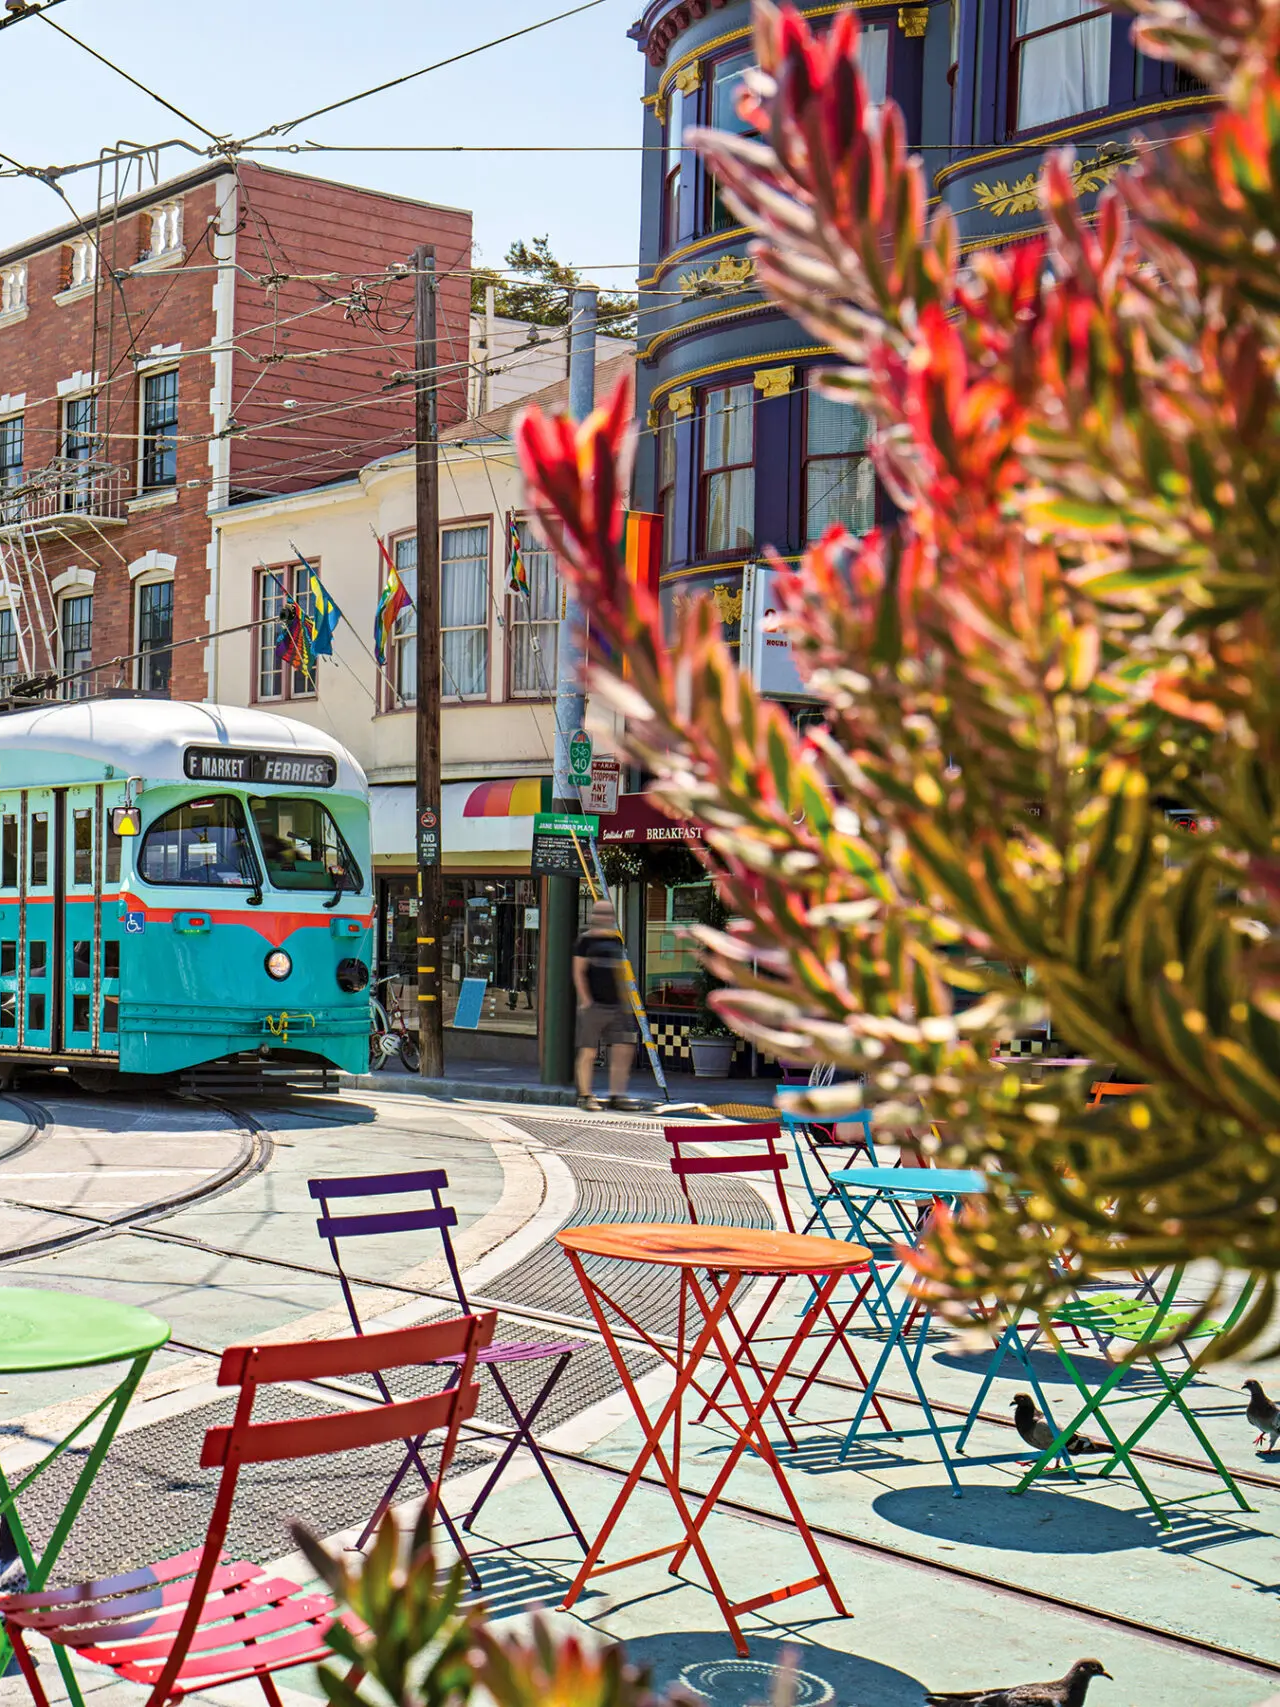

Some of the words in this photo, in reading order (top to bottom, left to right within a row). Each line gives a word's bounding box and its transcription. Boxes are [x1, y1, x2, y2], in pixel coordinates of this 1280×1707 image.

[766, 639, 788, 648] HOURS
[189, 755, 198, 775] F
[201, 757, 244, 778] MARKET
[264, 761, 324, 782] FERRIES
[573, 758, 587, 770] 40
[593, 772, 617, 782] STOPPING
[591, 783, 607, 792] ANY
[590, 793, 607, 803] TIME
[577, 824, 594, 832] PLAZA
[423, 833, 435, 843] NO
[646, 827, 703, 840] BREAKFAST
